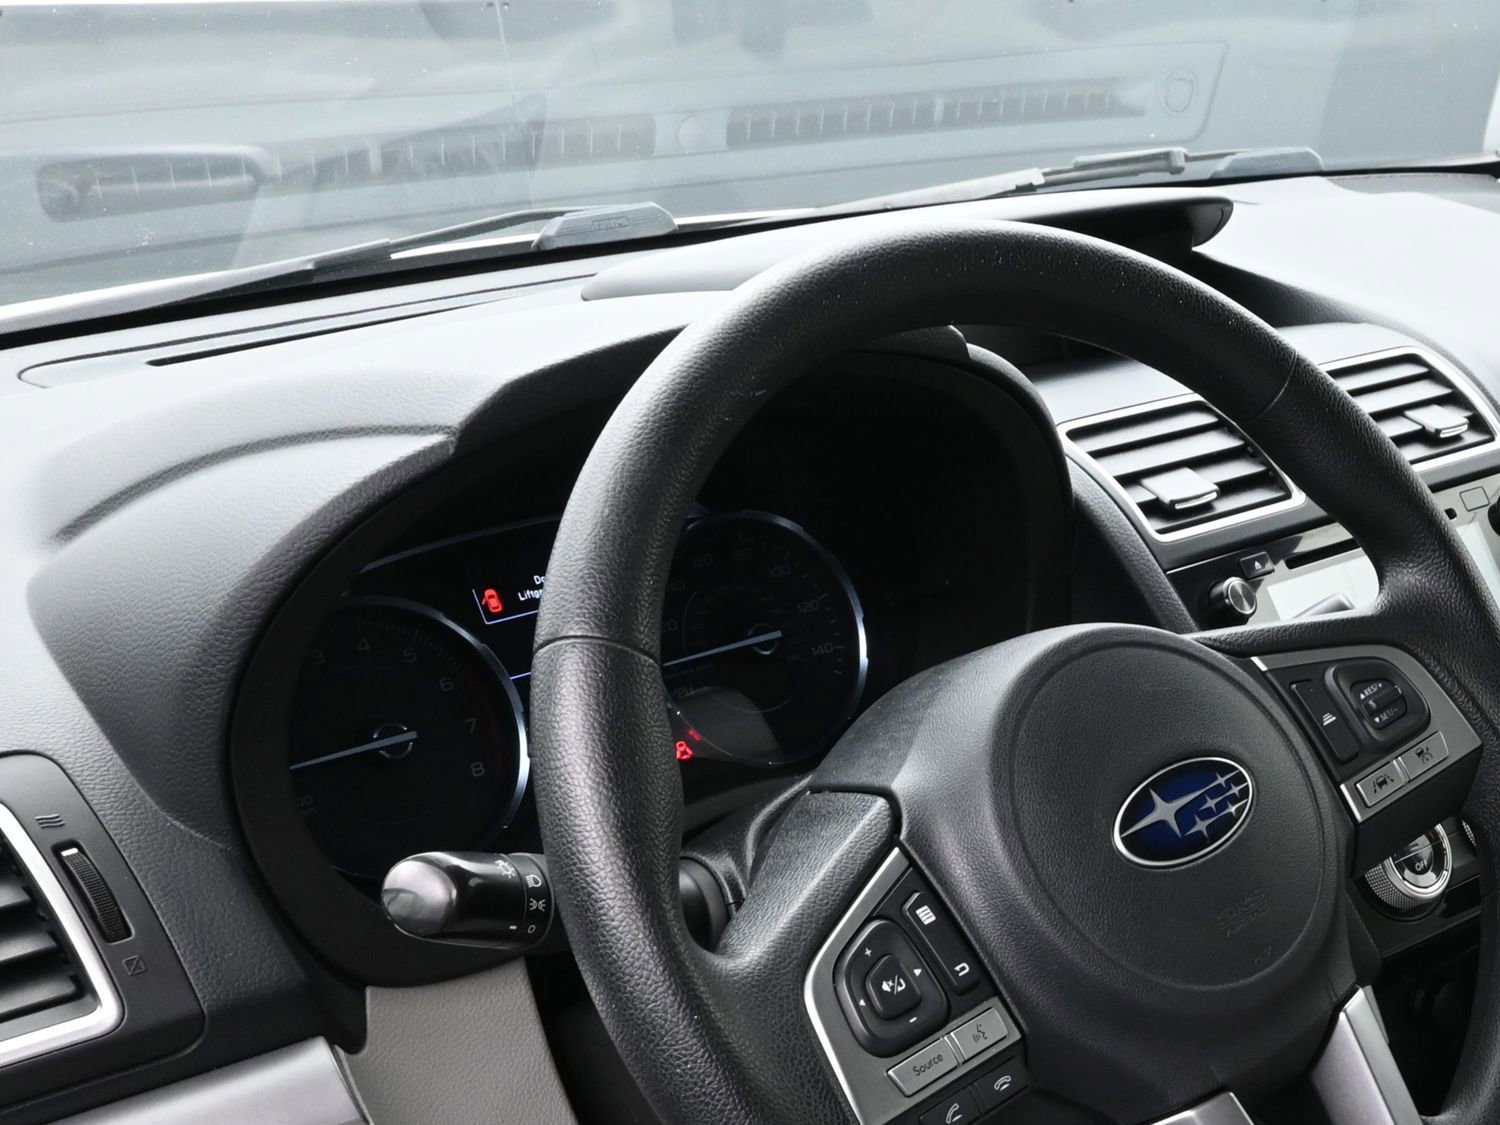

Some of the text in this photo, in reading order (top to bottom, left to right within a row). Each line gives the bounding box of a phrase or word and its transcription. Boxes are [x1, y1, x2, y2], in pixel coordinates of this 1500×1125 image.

[796, 599, 821, 613] 120
[356, 637, 372, 653] 4
[810, 642, 834, 656] 140
[402, 647, 418, 664] 5
[439, 676, 455, 692] 6
[464, 718, 479, 734] 7
[470, 761, 486, 777] 8
[912, 1053, 944, 1077] Source
